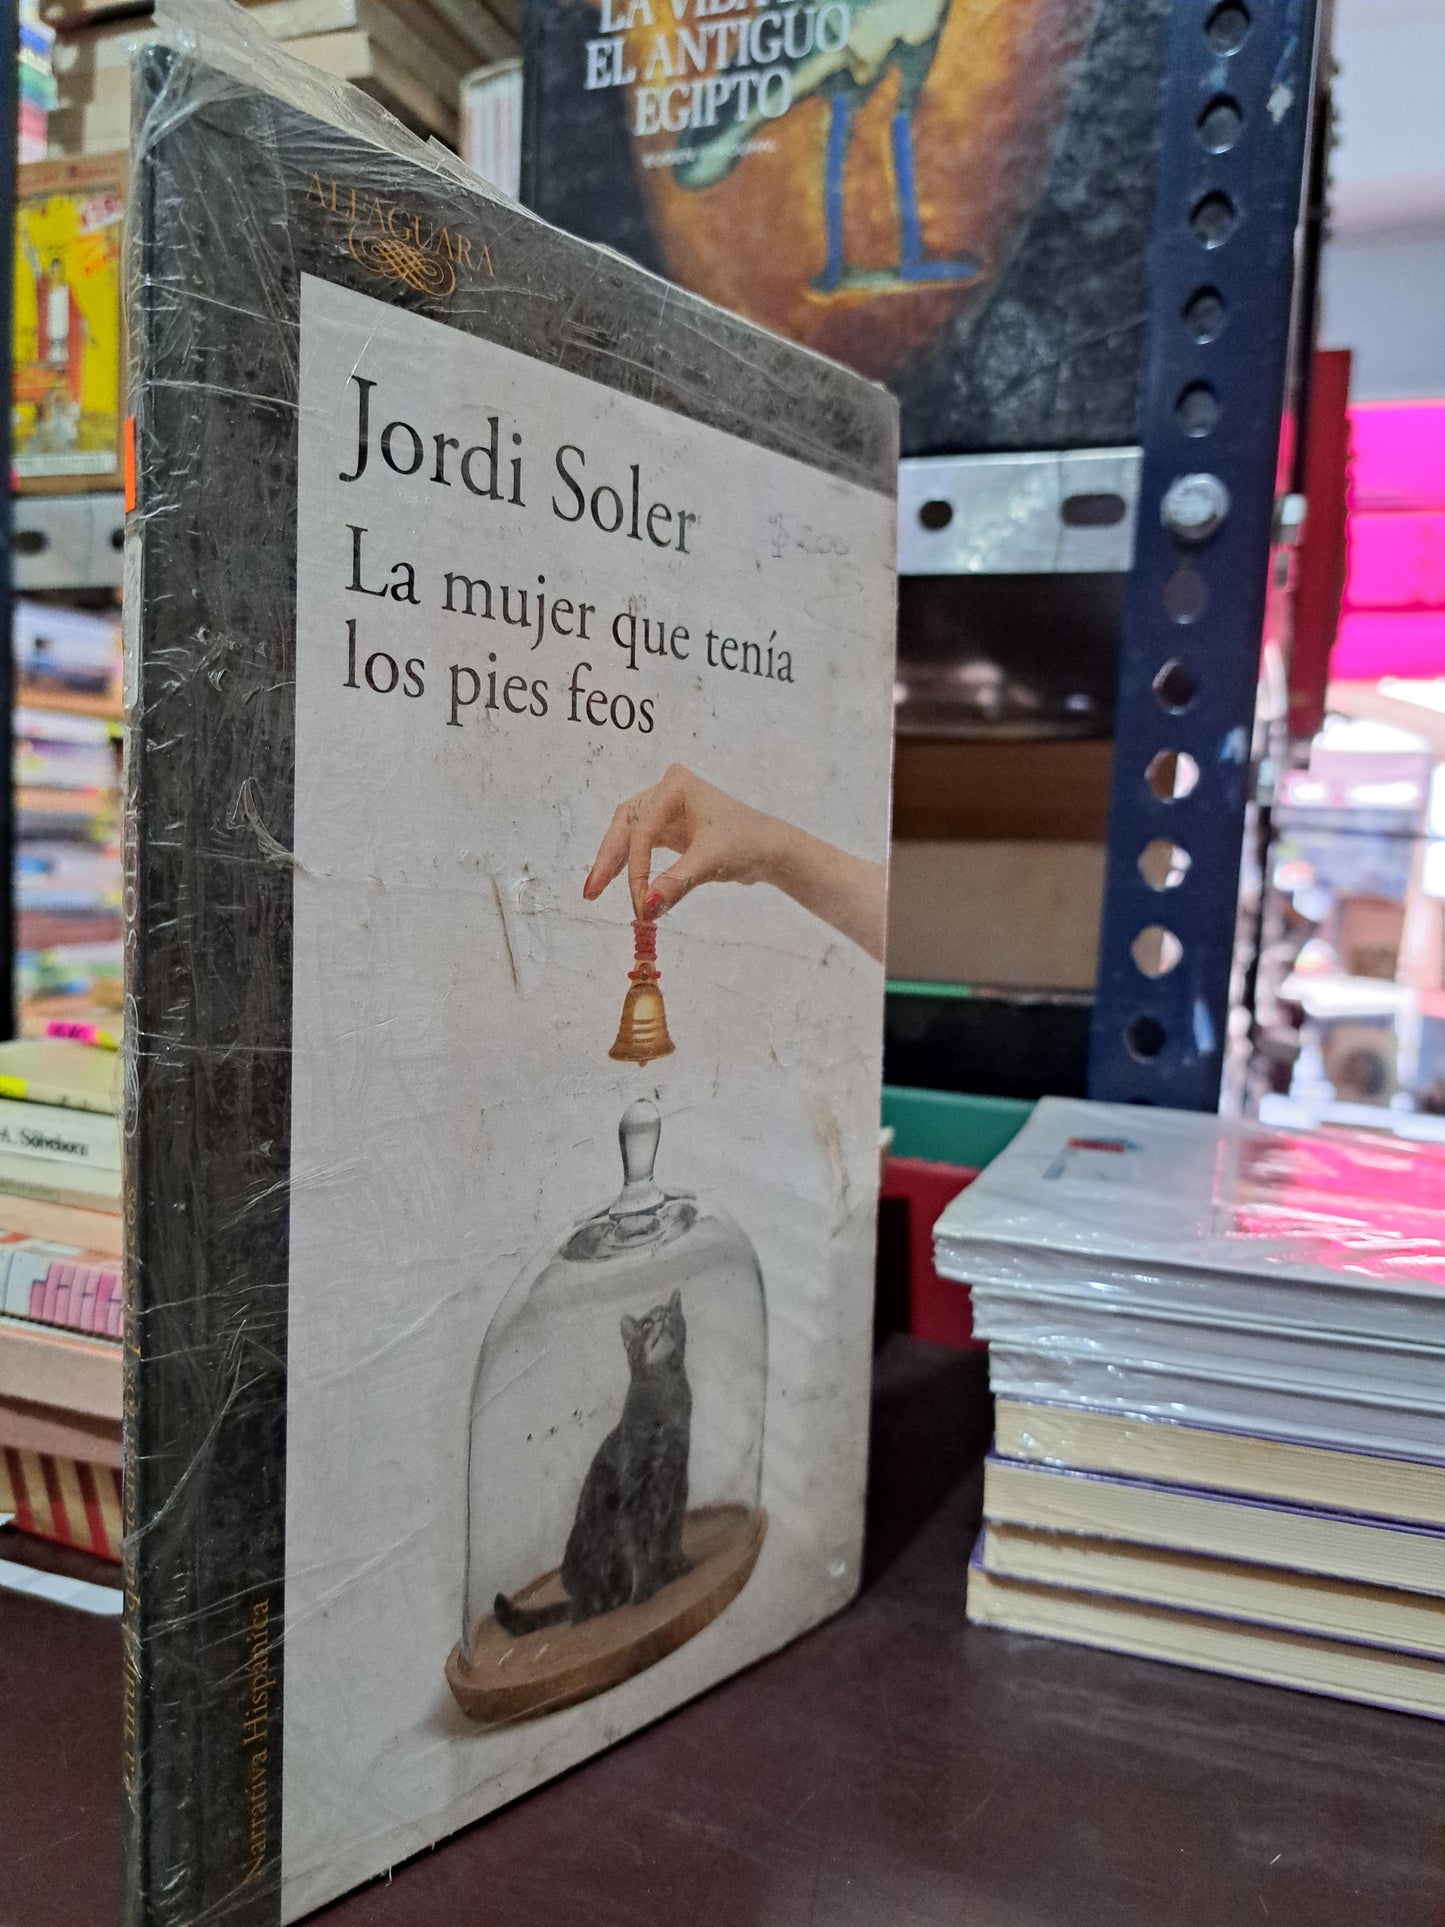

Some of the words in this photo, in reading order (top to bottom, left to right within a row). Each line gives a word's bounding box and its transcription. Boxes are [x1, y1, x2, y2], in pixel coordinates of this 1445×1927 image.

[584, 37, 637, 90] EL
[645, 4, 851, 81] ANTIGUO
[633, 67, 792, 137] EGIPTO
[304, 171, 495, 279] ALFAGUARA
[338, 375, 526, 507] Jordi
[552, 444, 697, 555] Soler
[345, 523, 421, 605] La
[441, 574, 596, 651] mujer
[612, 613, 690, 671] que
[705, 629, 795, 684] tenía
[343, 618, 425, 698] los
[446, 652, 549, 727] pies
[567, 662, 655, 734] feos
